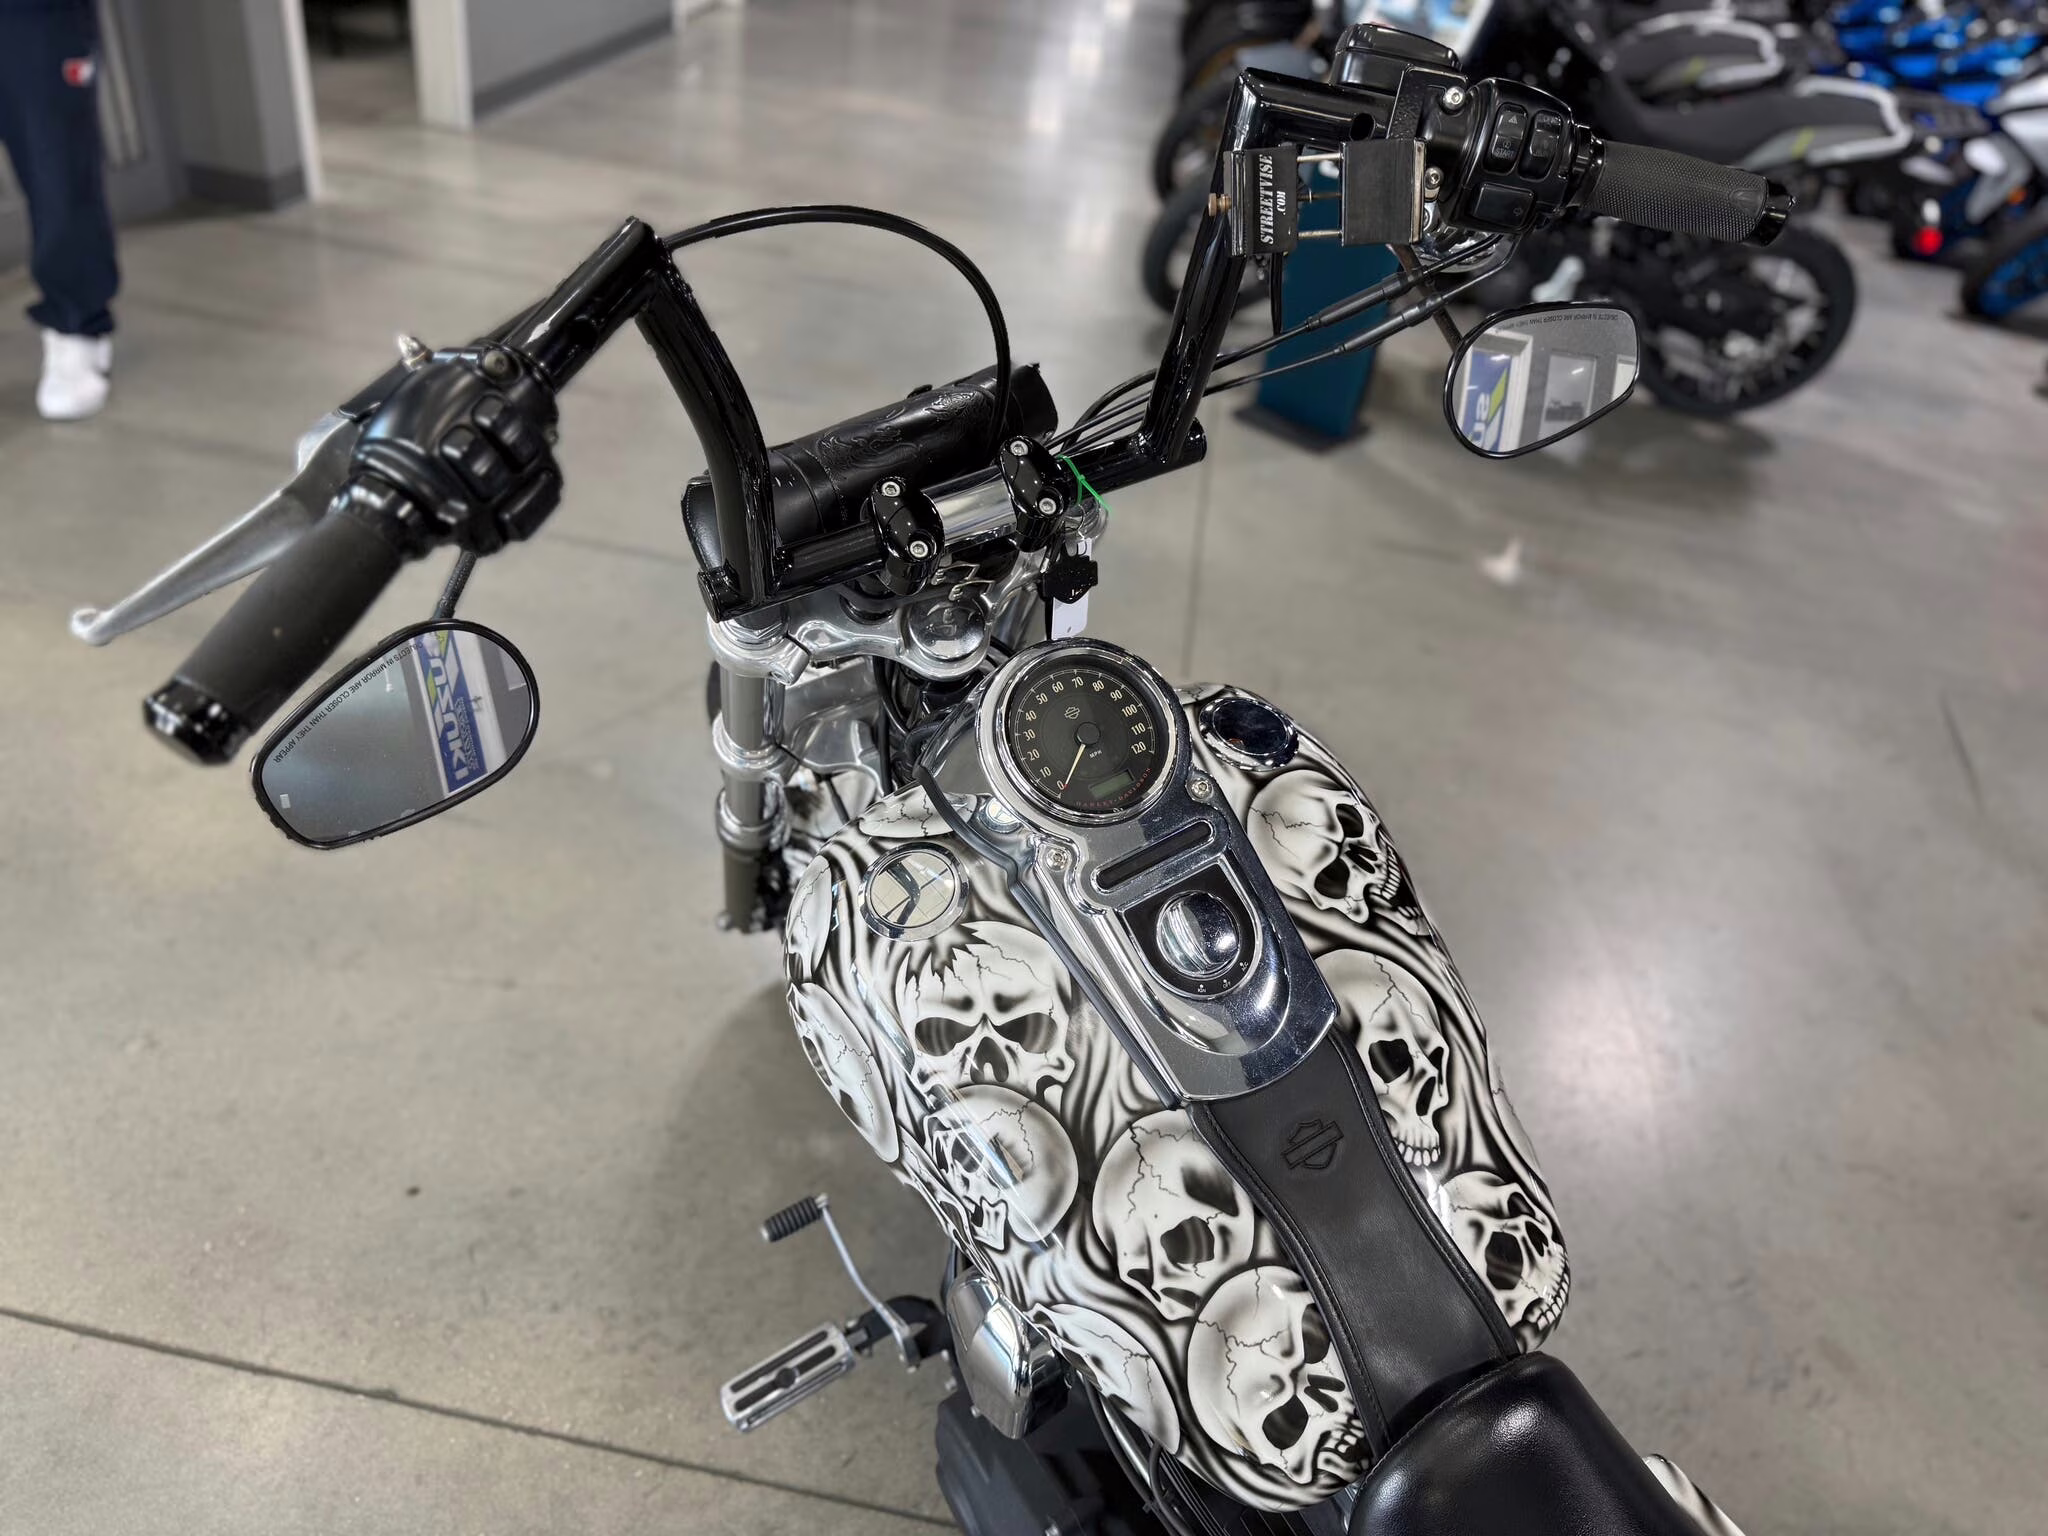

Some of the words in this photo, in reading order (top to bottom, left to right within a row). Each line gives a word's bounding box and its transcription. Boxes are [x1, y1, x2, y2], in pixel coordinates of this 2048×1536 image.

[1259, 154, 1274, 245] STREETVISE
[1276, 191, 1286, 215] .COM
[1543, 315, 1563, 323] CLOSER
[393, 641, 424, 661] OBJECTS
[386, 658, 395, 667] IN
[361, 663, 387, 684] MIRROR
[348, 682, 362, 694] ARE
[1051, 681, 1064, 693] 60
[1071, 676, 1084, 689] 70
[1092, 680, 1105, 692] 80
[325, 690, 350, 713] CLOSER
[1035, 692, 1049, 705] 50
[1110, 689, 1123, 701] 90
[1025, 710, 1037, 722] 40
[1121, 704, 1138, 717] 100
[309, 710, 328, 727] THAN
[295, 725, 312, 742] THEY
[1023, 729, 1036, 742] 30
[1130, 722, 1146, 736] 110
[273, 739, 296, 763] APPEAR
[1027, 748, 1040, 761] 20
[1089, 749, 1103, 759] MPH
[1131, 741, 1147, 755] 120
[1040, 766, 1052, 778] 10
[1056, 780, 1065, 791] 0
